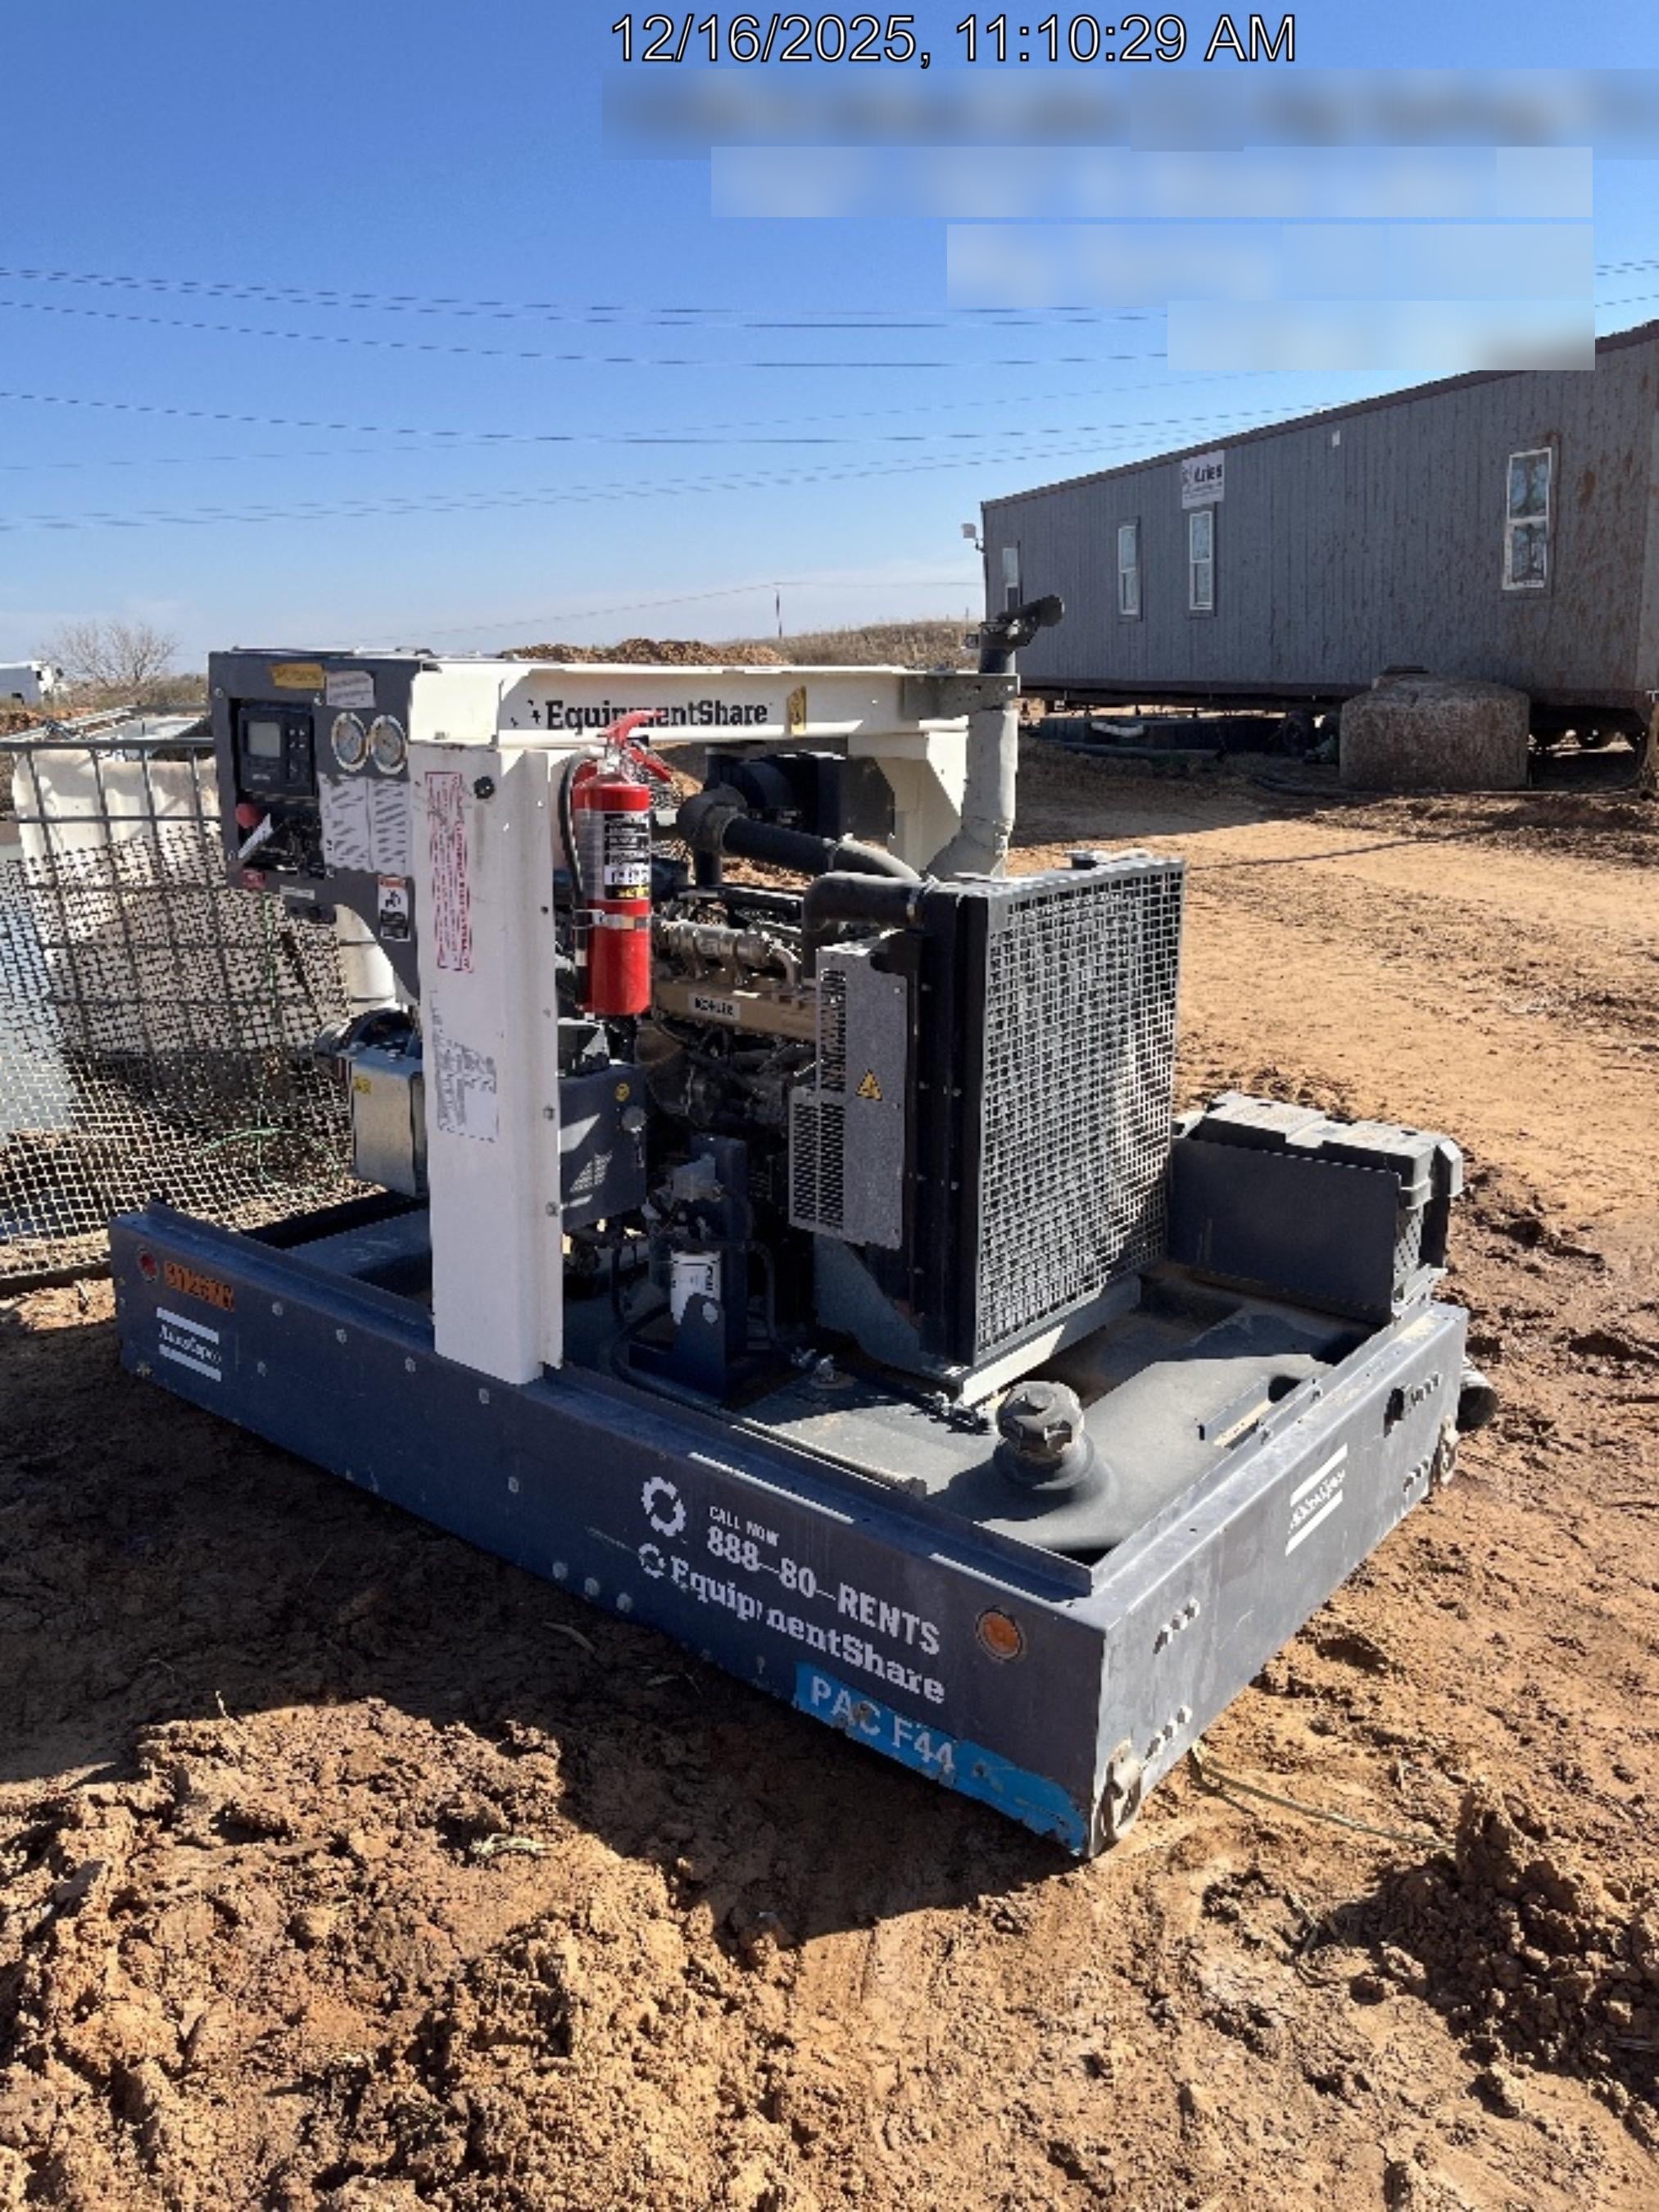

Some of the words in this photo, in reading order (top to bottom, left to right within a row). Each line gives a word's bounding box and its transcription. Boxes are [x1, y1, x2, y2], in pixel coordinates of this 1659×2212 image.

[709, 1506, 741, 1530] CALL
[746, 1521, 780, 1547] NOW
[810, 1675, 882, 1736] PAC
[892, 1715, 956, 1773] F44
